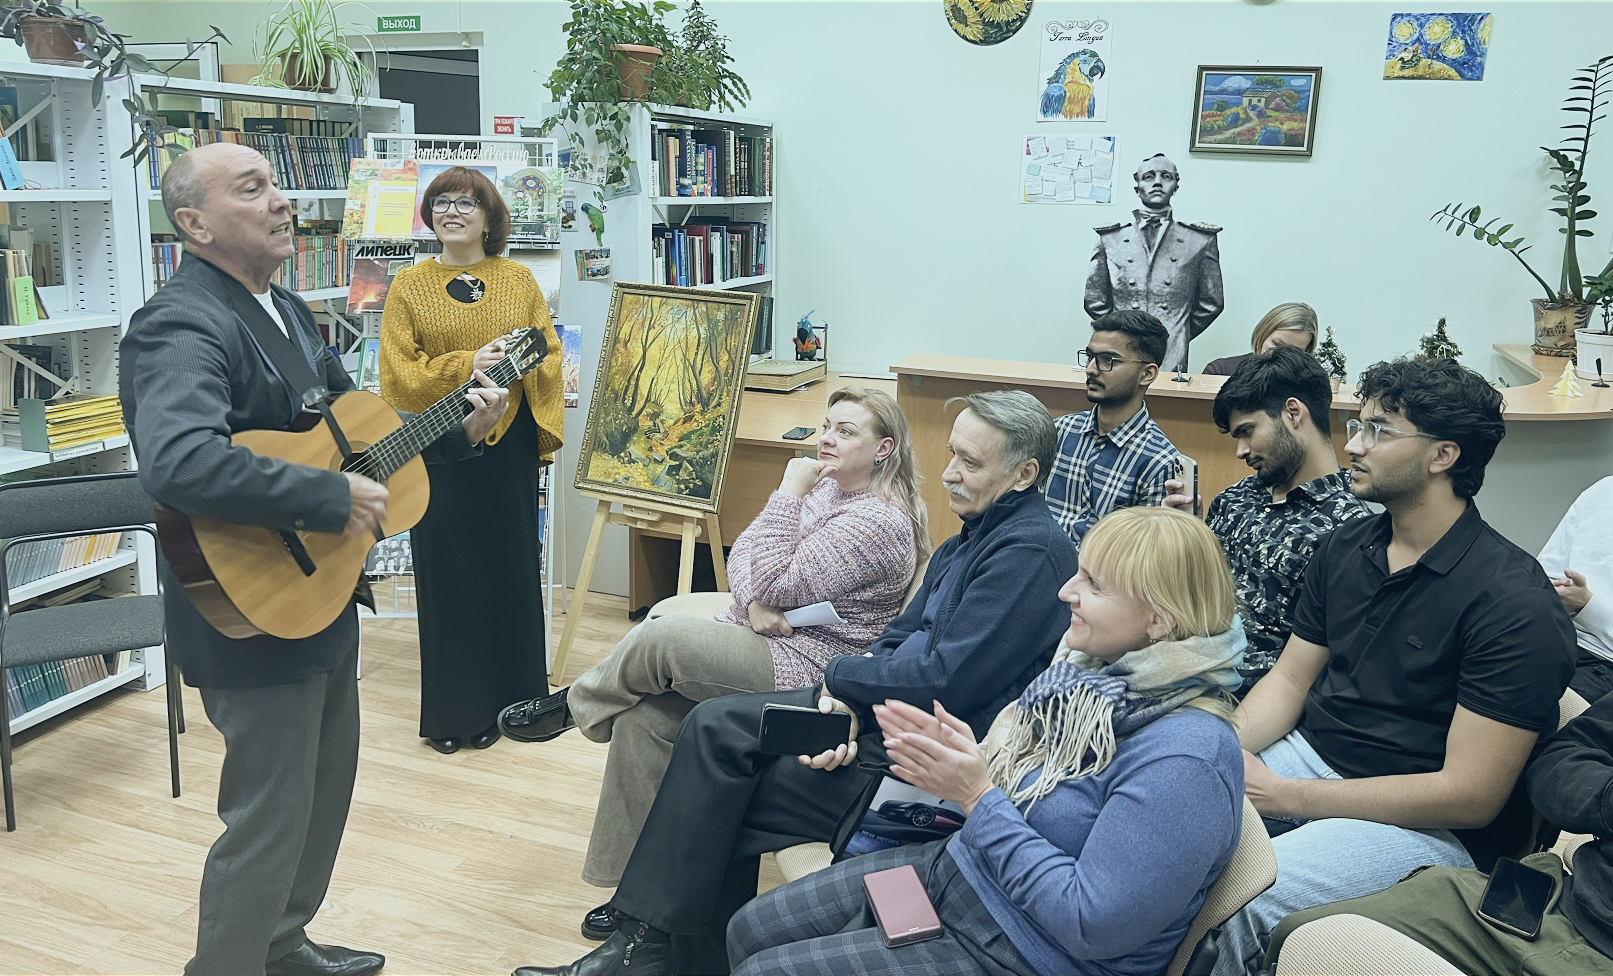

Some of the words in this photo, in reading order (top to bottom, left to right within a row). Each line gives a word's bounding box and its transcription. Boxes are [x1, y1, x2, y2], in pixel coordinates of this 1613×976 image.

[382, 18, 416, 29] ВЫХОД
[1050, 31, 1072, 41] Terra
[1076, 31, 1104, 44] Lingua
